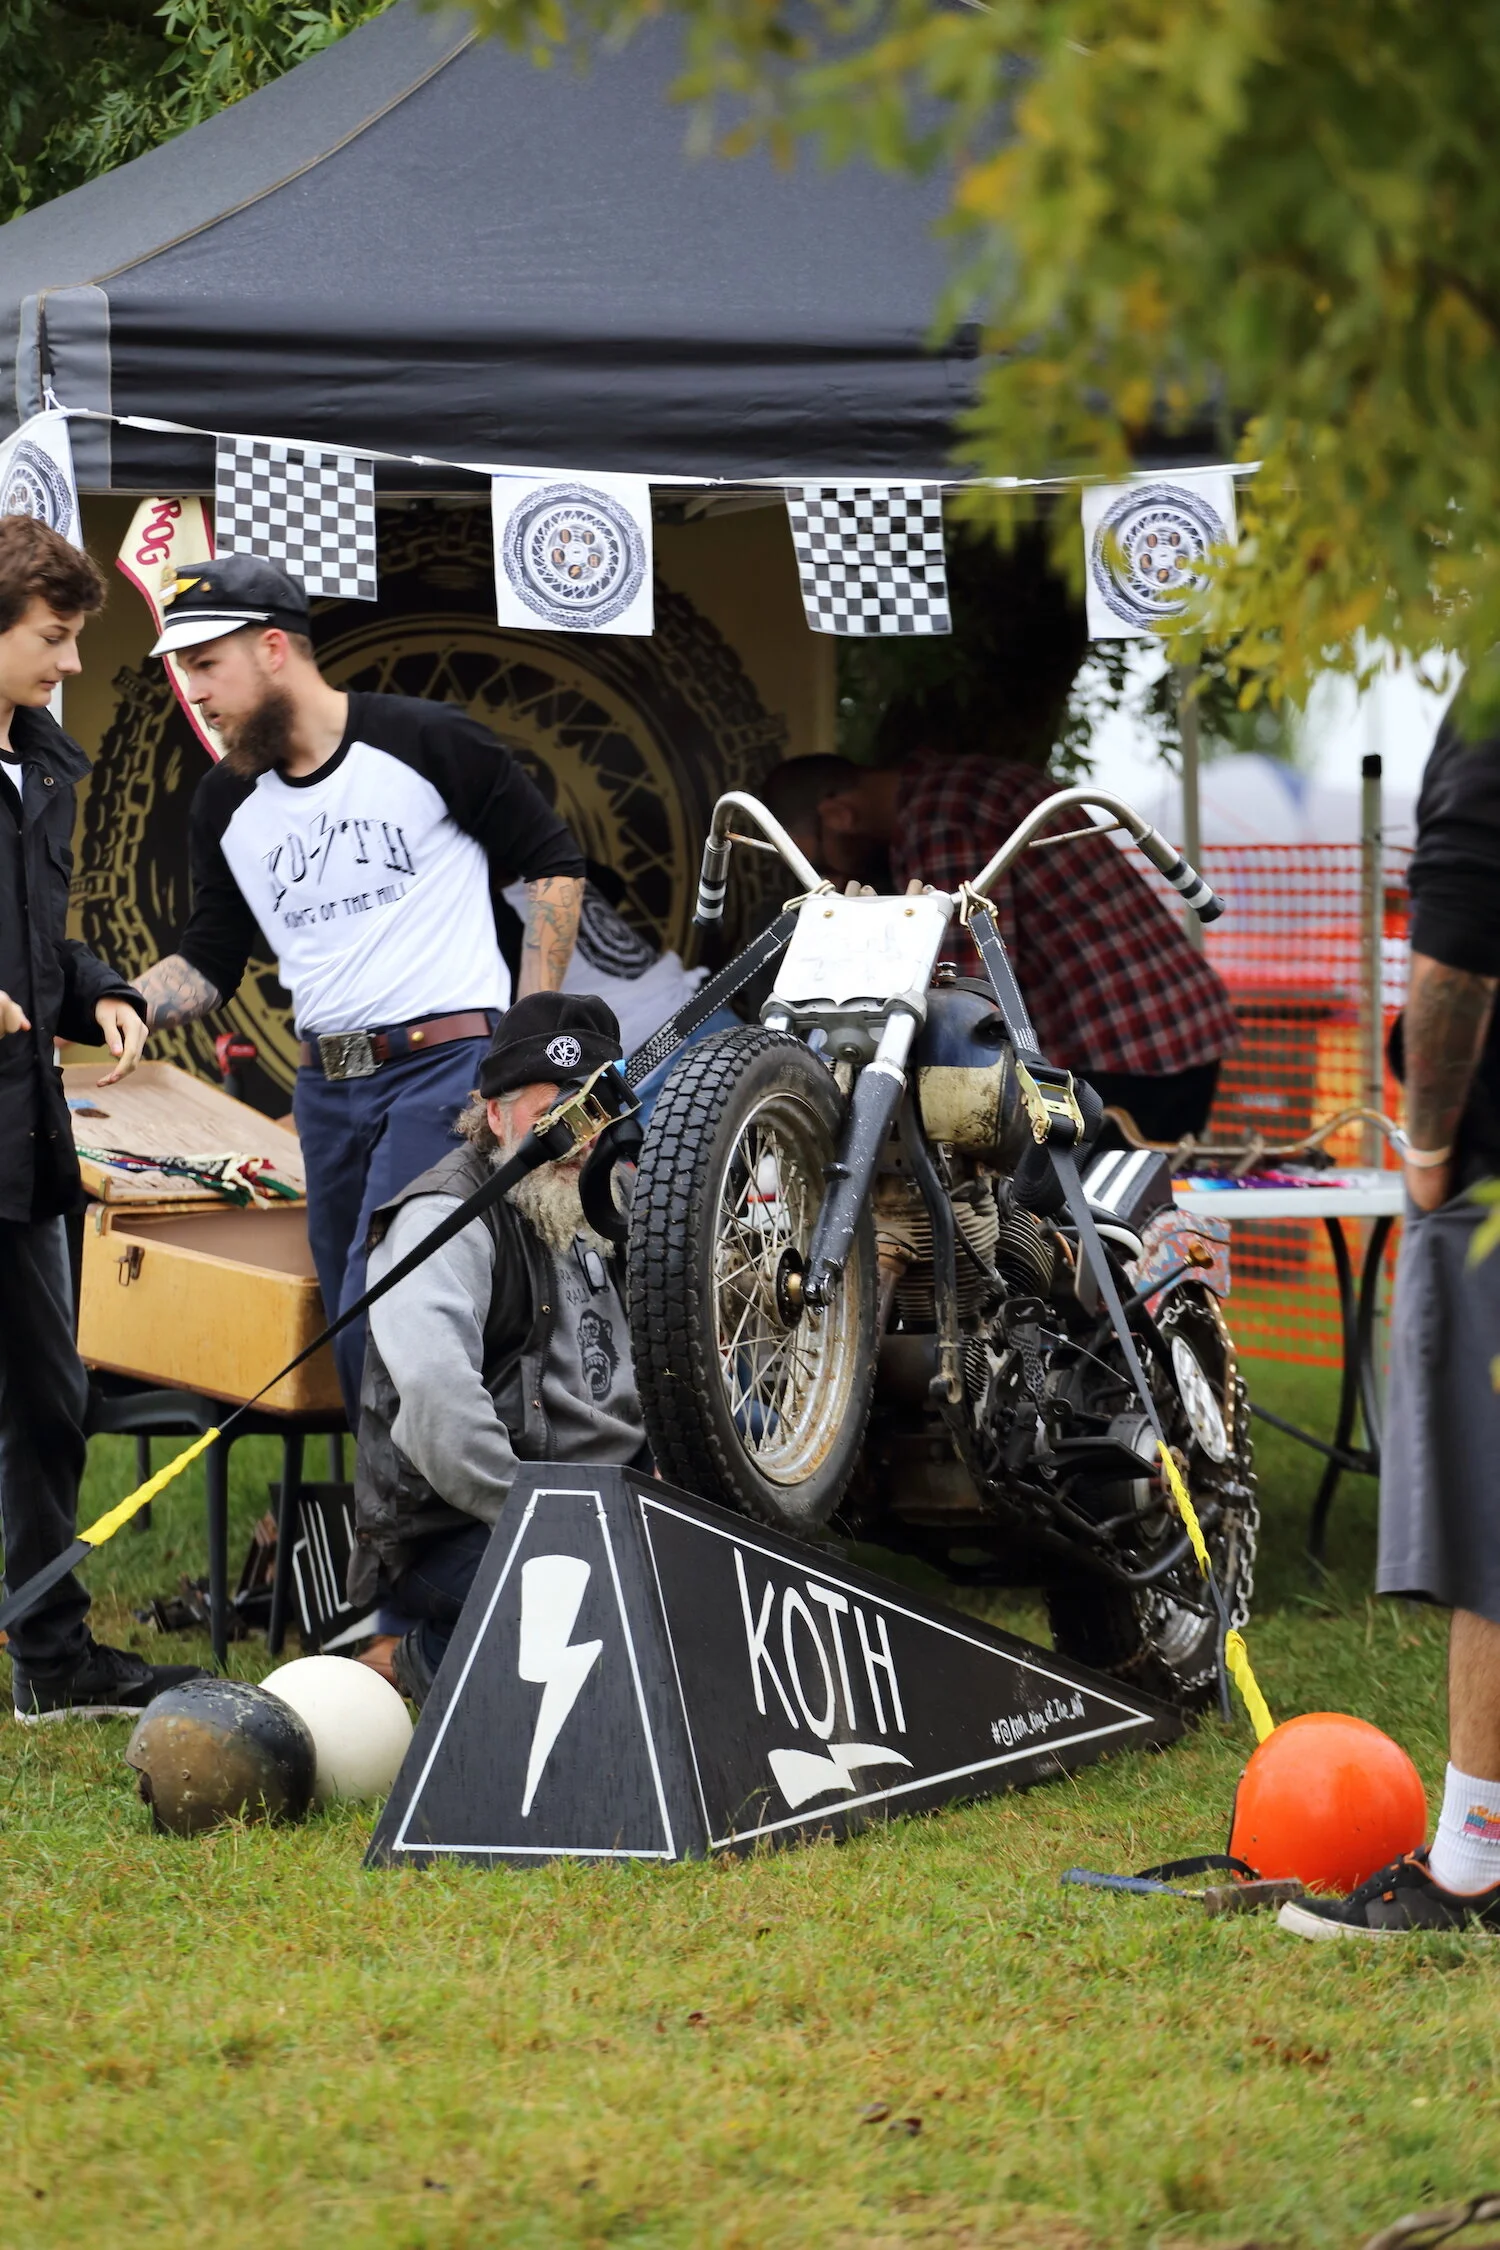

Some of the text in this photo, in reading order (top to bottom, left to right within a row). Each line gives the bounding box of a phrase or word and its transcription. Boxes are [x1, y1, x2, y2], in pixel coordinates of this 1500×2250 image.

[136, 497, 182, 565] ROG
[320, 901, 338, 921] OF
[341, 893, 373, 915] THE
[733, 1546, 907, 1741] KOTH
